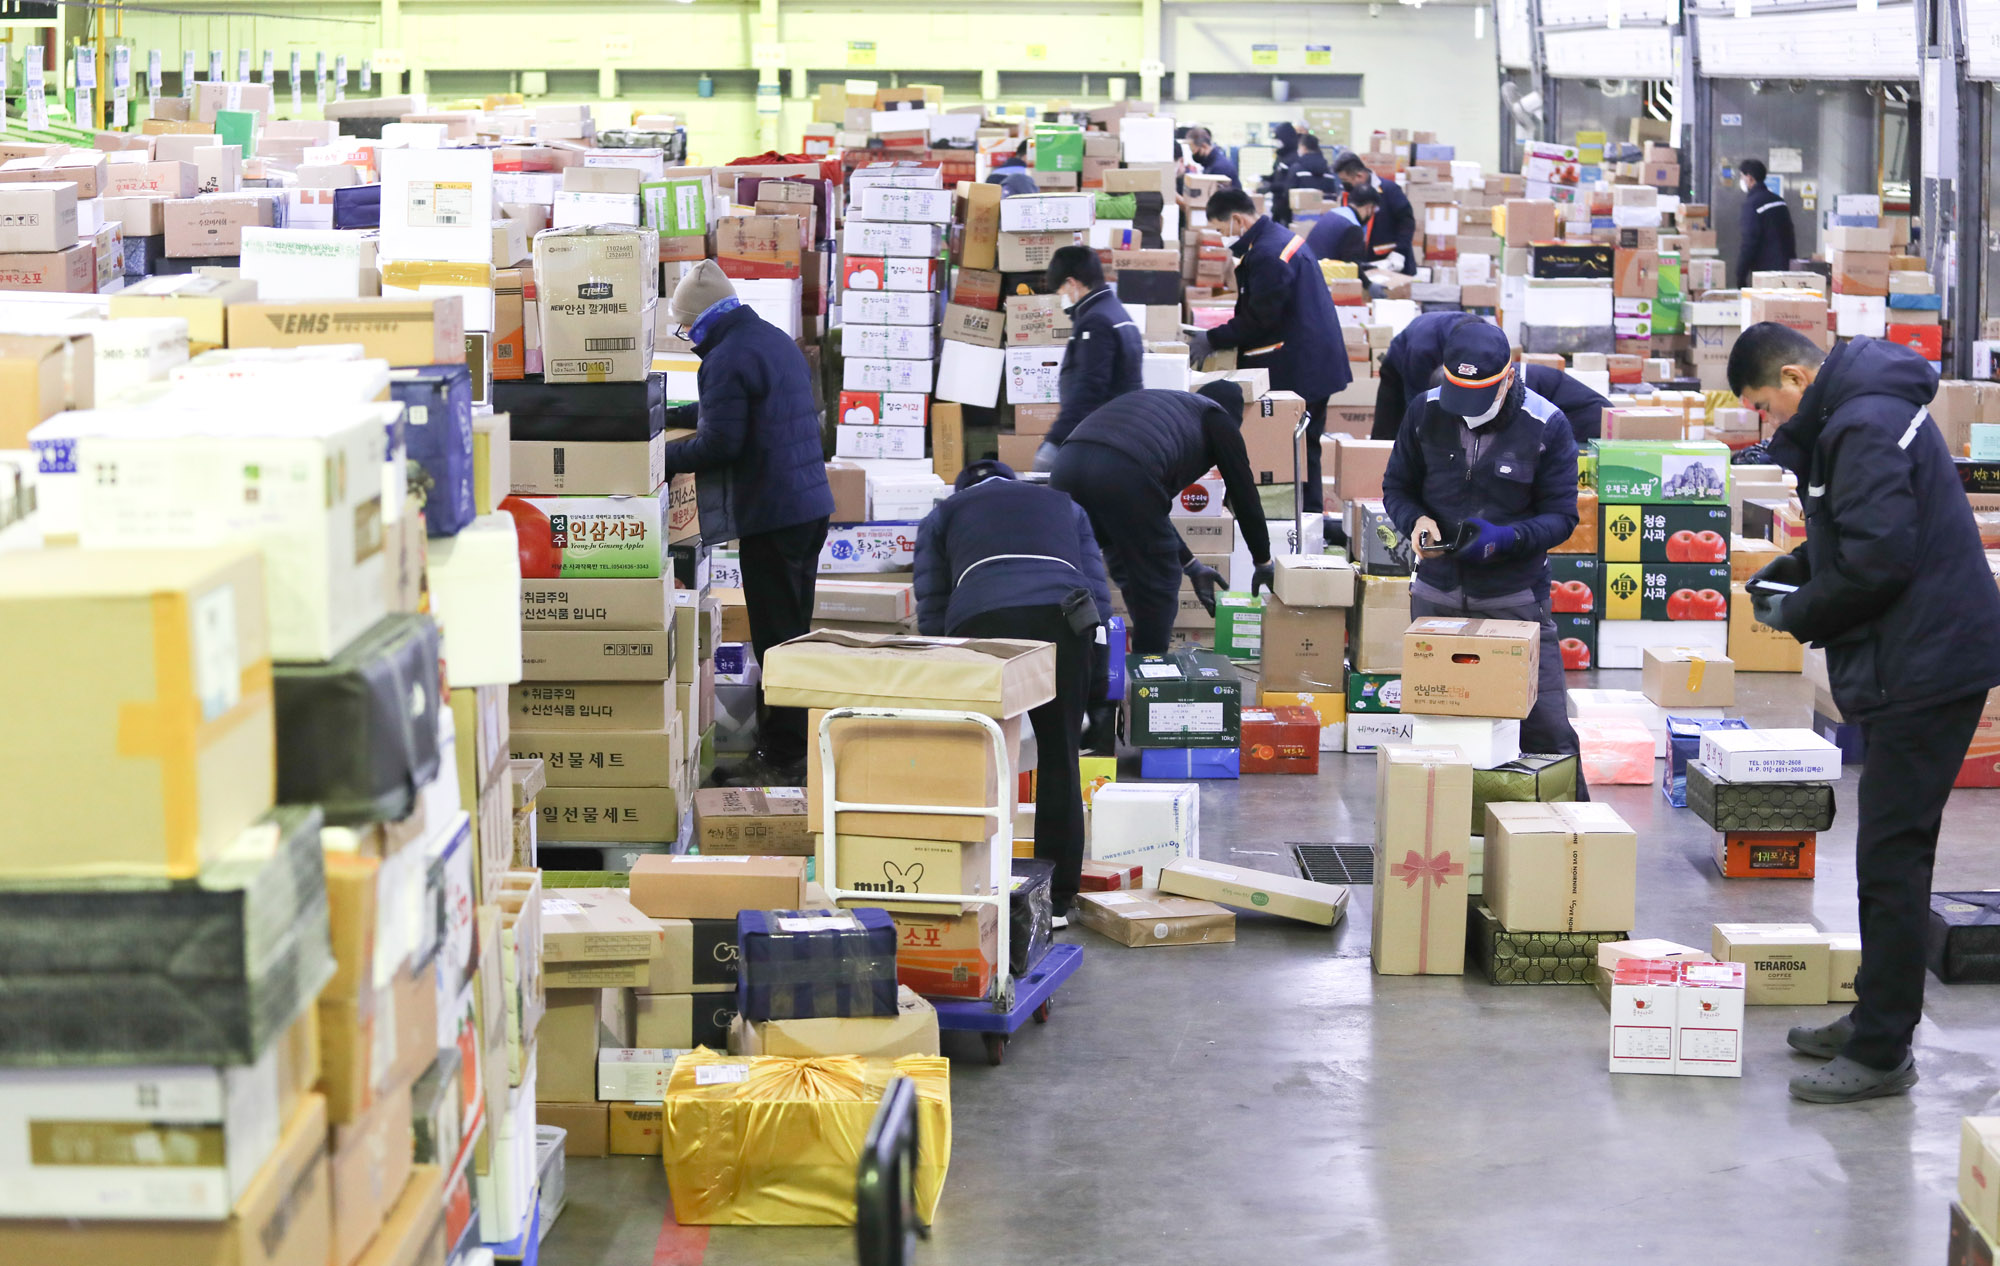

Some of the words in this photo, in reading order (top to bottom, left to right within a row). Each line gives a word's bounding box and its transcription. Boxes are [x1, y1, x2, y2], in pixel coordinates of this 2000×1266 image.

[891, 265, 923, 275] 장수사과
[21, 272, 43, 284] 소포
[565, 304, 586, 315] 안심
[588, 303, 628, 315] 깔개매트
[284, 313, 330, 334] EMS
[887, 403, 919, 411] 장수사과
[1605, 484, 1629, 494] 우체국
[1630, 482, 1652, 496] 쇼핑
[1643, 514, 1666, 528] 청송
[569, 520, 648, 542] 인삼사과
[1643, 529, 1666, 541] 사과
[570, 542, 597, 551] Yeong-Ju
[598, 542, 623, 551] Ginseng
[625, 542, 644, 550] Apples
[1644, 573, 1667, 587] 청송
[524, 592, 569, 604] 취급주의
[1643, 587, 1666, 600] 사과
[524, 608, 569, 620] 신선식품
[573, 608, 607, 620] 입니다
[531, 688, 575, 700] 취급주의
[531, 705, 575, 717] 신선식품
[579, 705, 613, 717] 입니다
[535, 807, 640, 824] 일선물세트
[903, 927, 942, 947] 소포
[1754, 961, 1807, 971] TERAROSA
[632, 1111, 652, 1121] EMS
